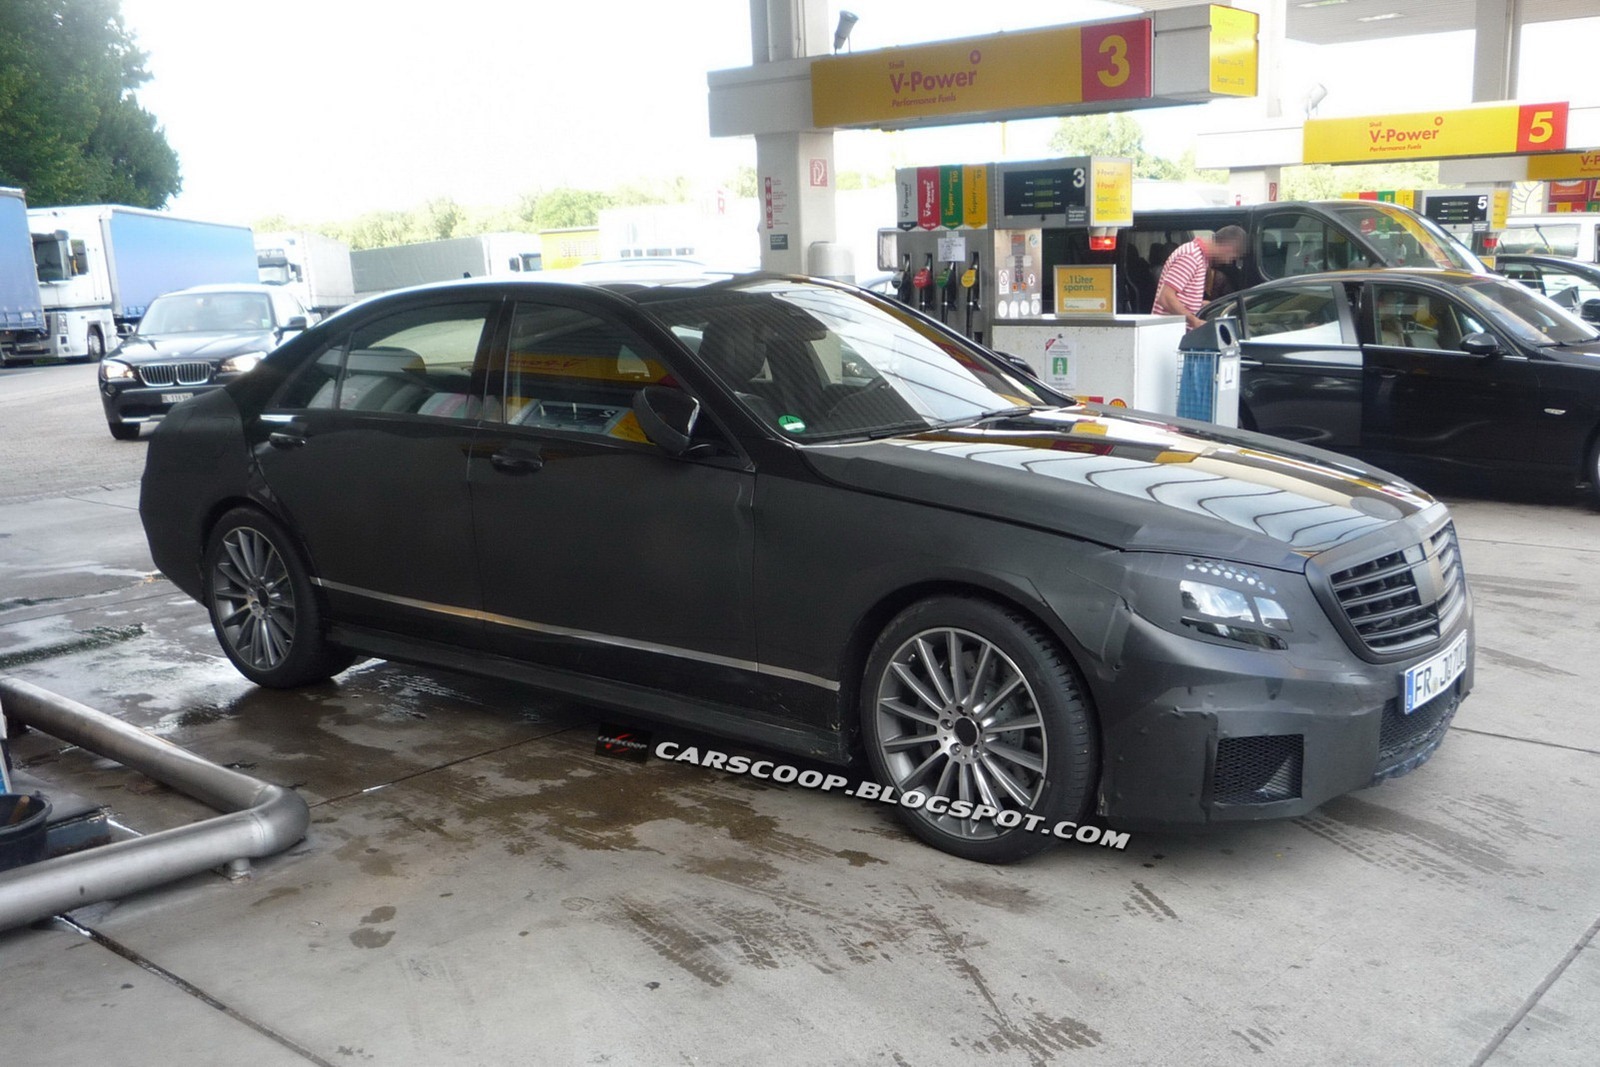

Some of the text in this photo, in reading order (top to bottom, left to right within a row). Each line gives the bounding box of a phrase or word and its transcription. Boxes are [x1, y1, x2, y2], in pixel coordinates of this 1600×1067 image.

[1097, 35, 1130, 88] 3
[889, 70, 977, 94] V-Power
[892, 93, 956, 107] Performance Fuels
[1528, 111, 1553, 143] 5
[1369, 129, 1439, 143] V-Power
[1072, 168, 1085, 188] 3
[1477, 197, 1487, 209] 5
[1064, 284, 1094, 292] sparen
[1074, 275, 1093, 284] Liter
[1415, 666, 1432, 702] FR
